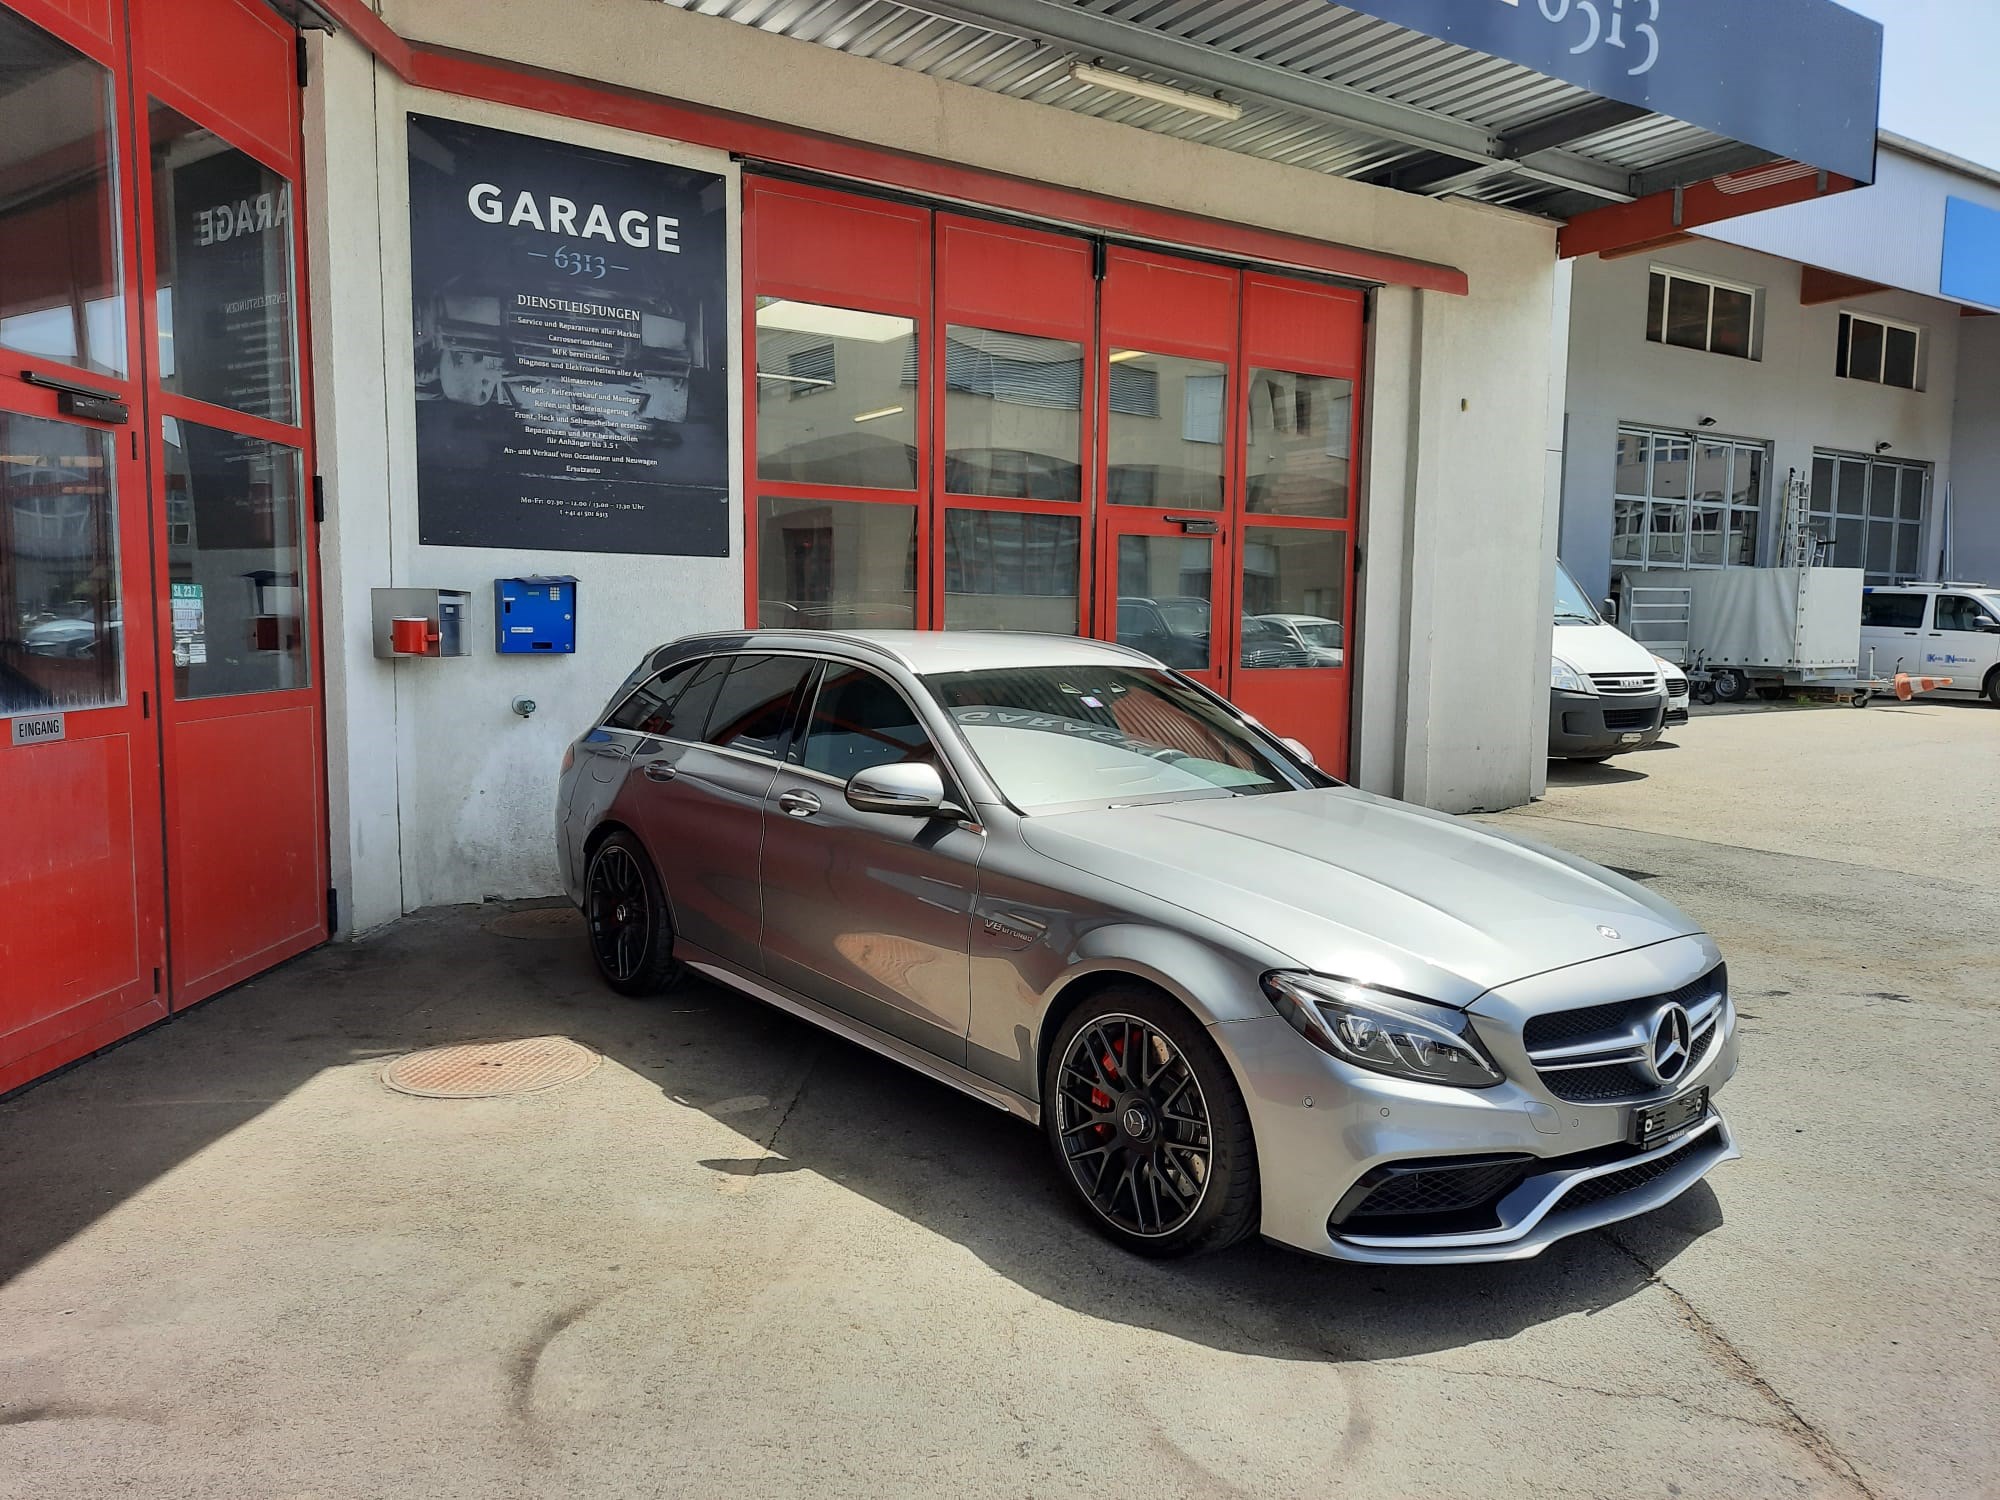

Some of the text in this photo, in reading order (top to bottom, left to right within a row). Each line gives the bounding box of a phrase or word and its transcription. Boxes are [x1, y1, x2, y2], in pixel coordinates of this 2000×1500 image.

[468, 183, 681, 254] GARAGE
[554, 245, 606, 279] 6313
[518, 294, 640, 321] DIENSTLEISTUNGEN
[518, 317, 640, 338] Service und Reparaturen aller Marken
[549, 335, 612, 348] Carrosseriearbeiten
[569, 350, 610, 360] bereitstellen
[519, 358, 549, 368] Diagnose
[551, 360, 563, 369] und
[566, 363, 615, 375] Elektroarbeiten
[617, 369, 631, 377] aller
[561, 376, 603, 386] Klimaservice
[552, 388, 598, 400] Reifenverkauf
[598, 392, 610, 401] und
[613, 394, 639, 404] Montage
[535, 401, 628, 416] Reifen und Rädereinlagerung
[539, 414, 554, 422] Heck
[571, 417, 619, 428] Seitenscheiben
[621, 422, 646, 430] ersetzen
[525, 426, 566, 437] Reparaturen
[598, 432, 638, 442] bereitstellen
[559, 438, 590, 447] Anhänger
[533, 449, 558, 457] Verkauf
[574, 452, 610, 462] Occasionen
[626, 456, 657, 465] Neuwagen
[566, 465, 601, 474] Ersatzauto
[19, 719, 60, 738] EINGANG
[984, 918, 1002, 931] V8
